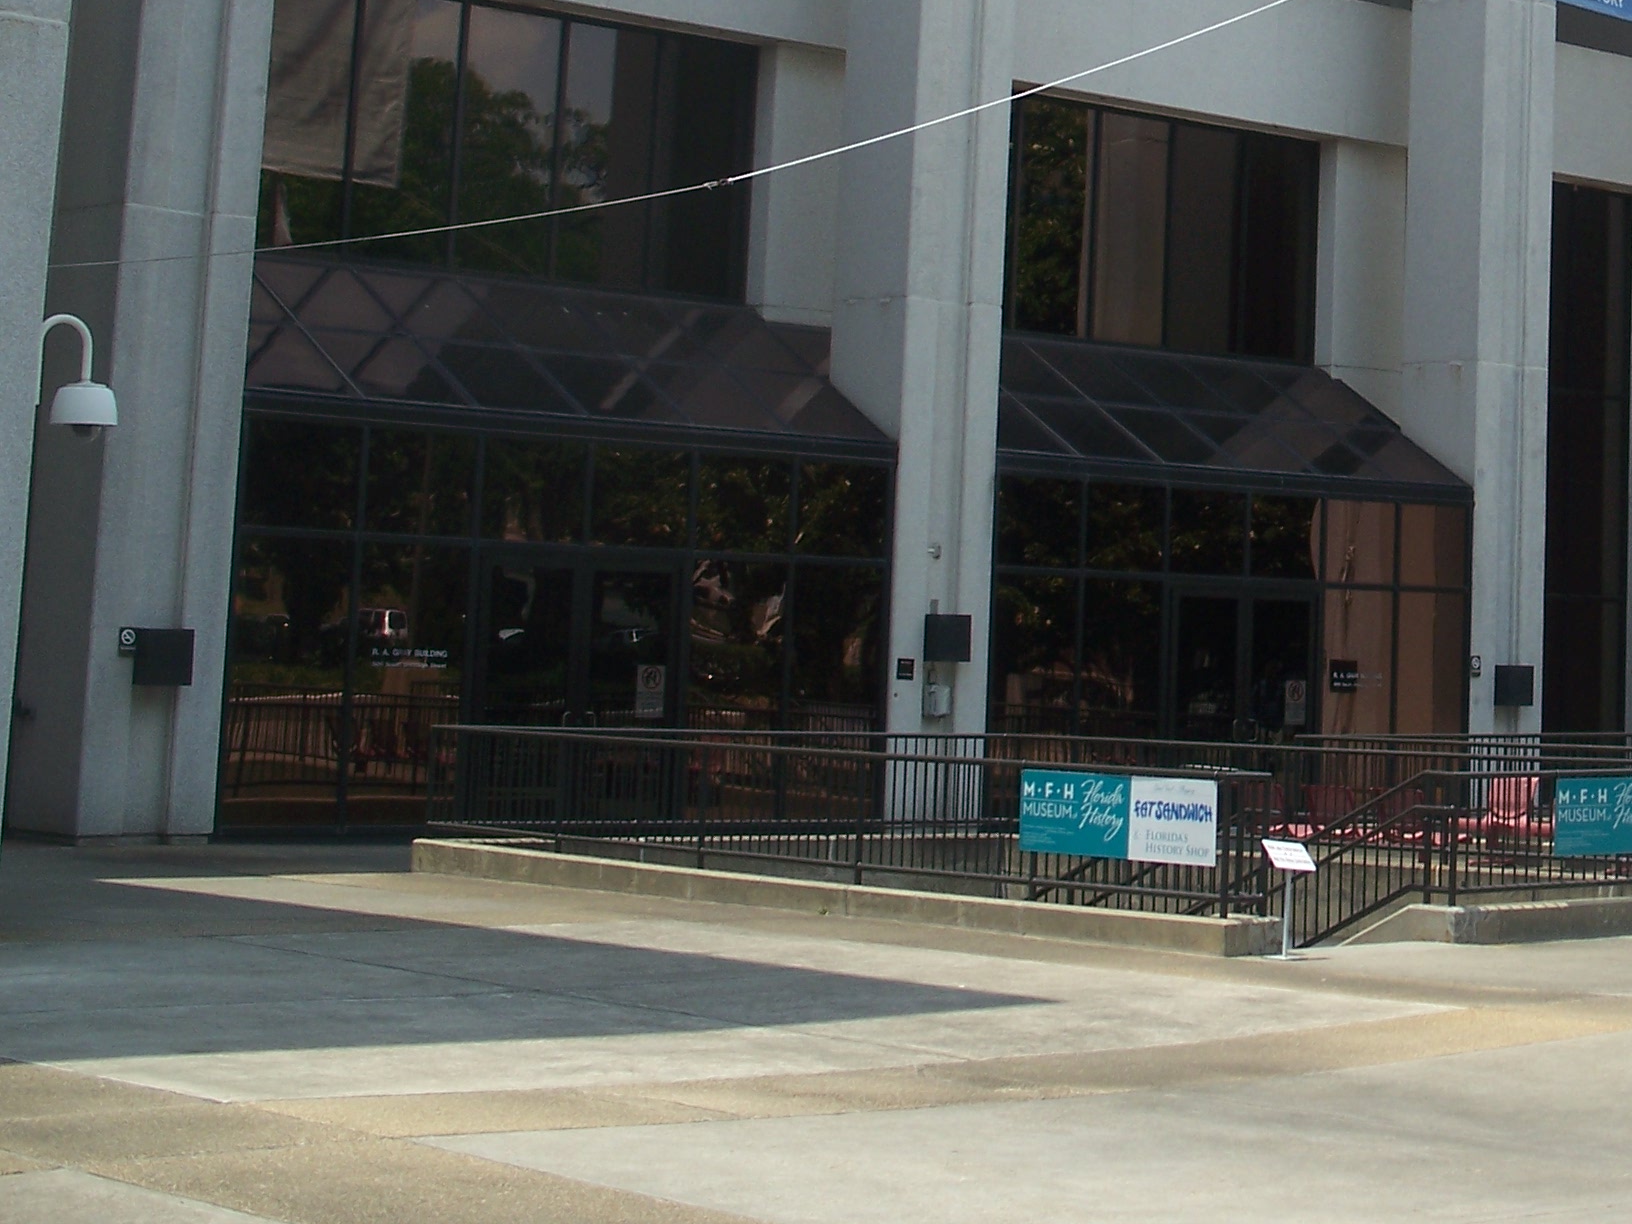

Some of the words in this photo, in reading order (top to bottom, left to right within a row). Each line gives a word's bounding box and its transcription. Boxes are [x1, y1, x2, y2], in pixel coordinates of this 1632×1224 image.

[392, 648, 412, 657] GY
[1080, 779, 1125, 808] Florida
[1023, 801, 1072, 818] MUSEUM
[1558, 807, 1607, 823] MUSEUM
[1078, 802, 1124, 842] History
